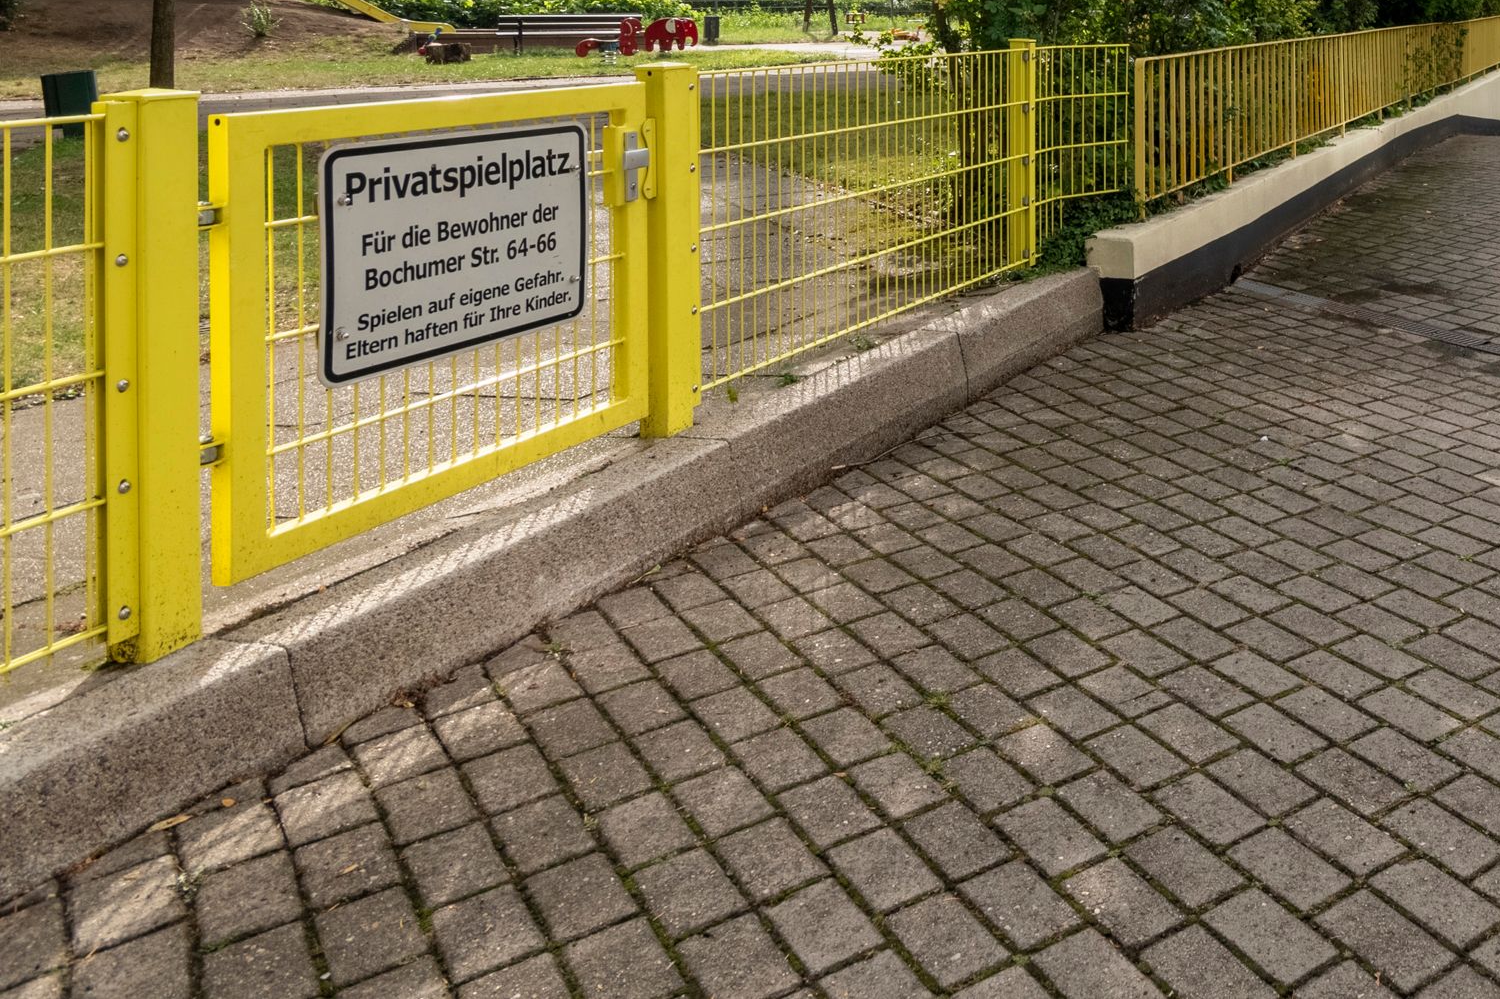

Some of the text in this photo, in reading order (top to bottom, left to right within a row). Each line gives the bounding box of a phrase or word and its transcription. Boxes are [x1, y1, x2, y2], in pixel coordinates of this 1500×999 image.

[345, 149, 570, 206] Privatspielplatz
[361, 203, 559, 256] Für die Bewohner der
[365, 231, 557, 290] Bochumer Str. 64-66
[346, 289, 572, 360] Eltern haften für Ihre Kinder.
[357, 268, 565, 332] Spielen auf eigene Gefahr.
